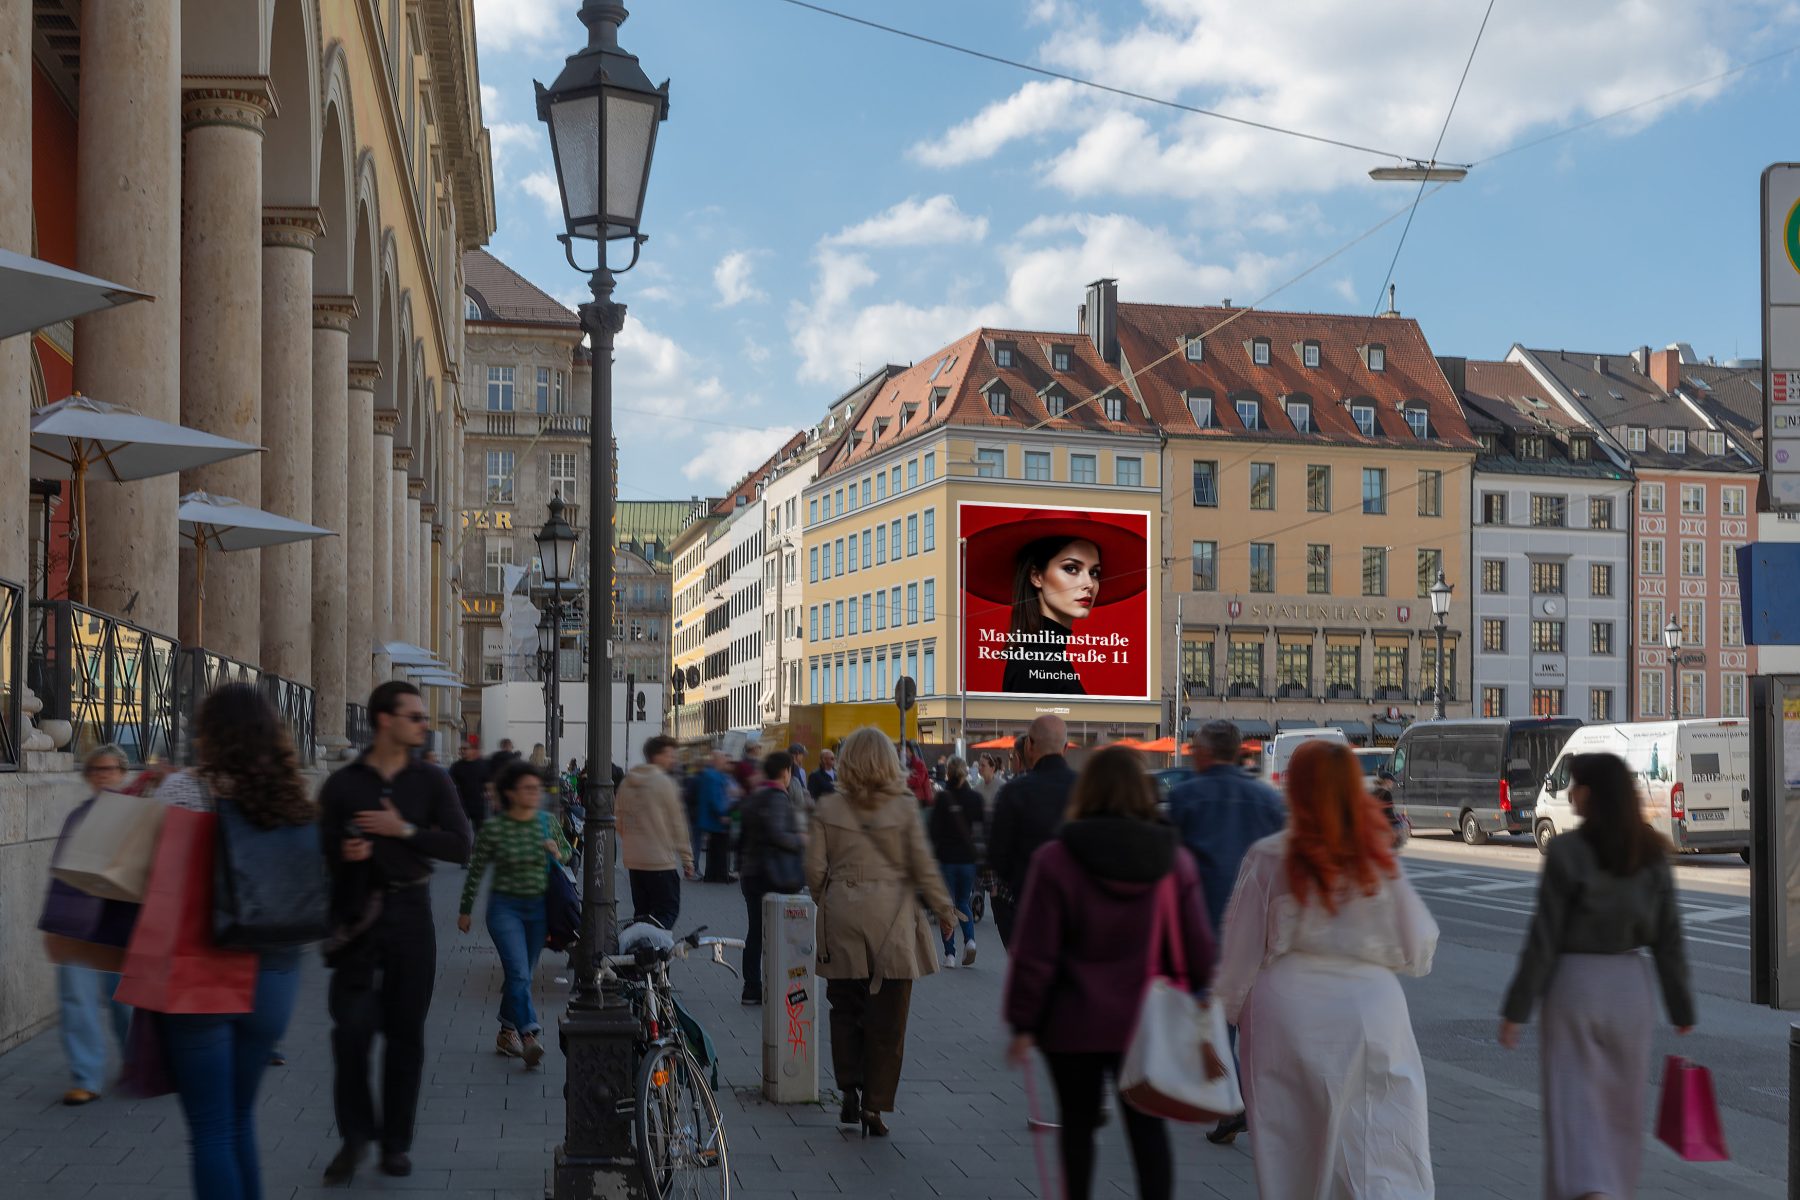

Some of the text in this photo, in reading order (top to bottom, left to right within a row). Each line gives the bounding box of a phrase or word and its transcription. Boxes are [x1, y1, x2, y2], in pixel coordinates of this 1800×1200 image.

[1251, 604, 1387, 621] SPATENHAUS
[979, 628, 1129, 647] Maximilianstraße
[978, 646, 1128, 664] Residenzstraße 11
[1029, 669, 1081, 681] München
[1542, 663, 1559, 672] IWC
